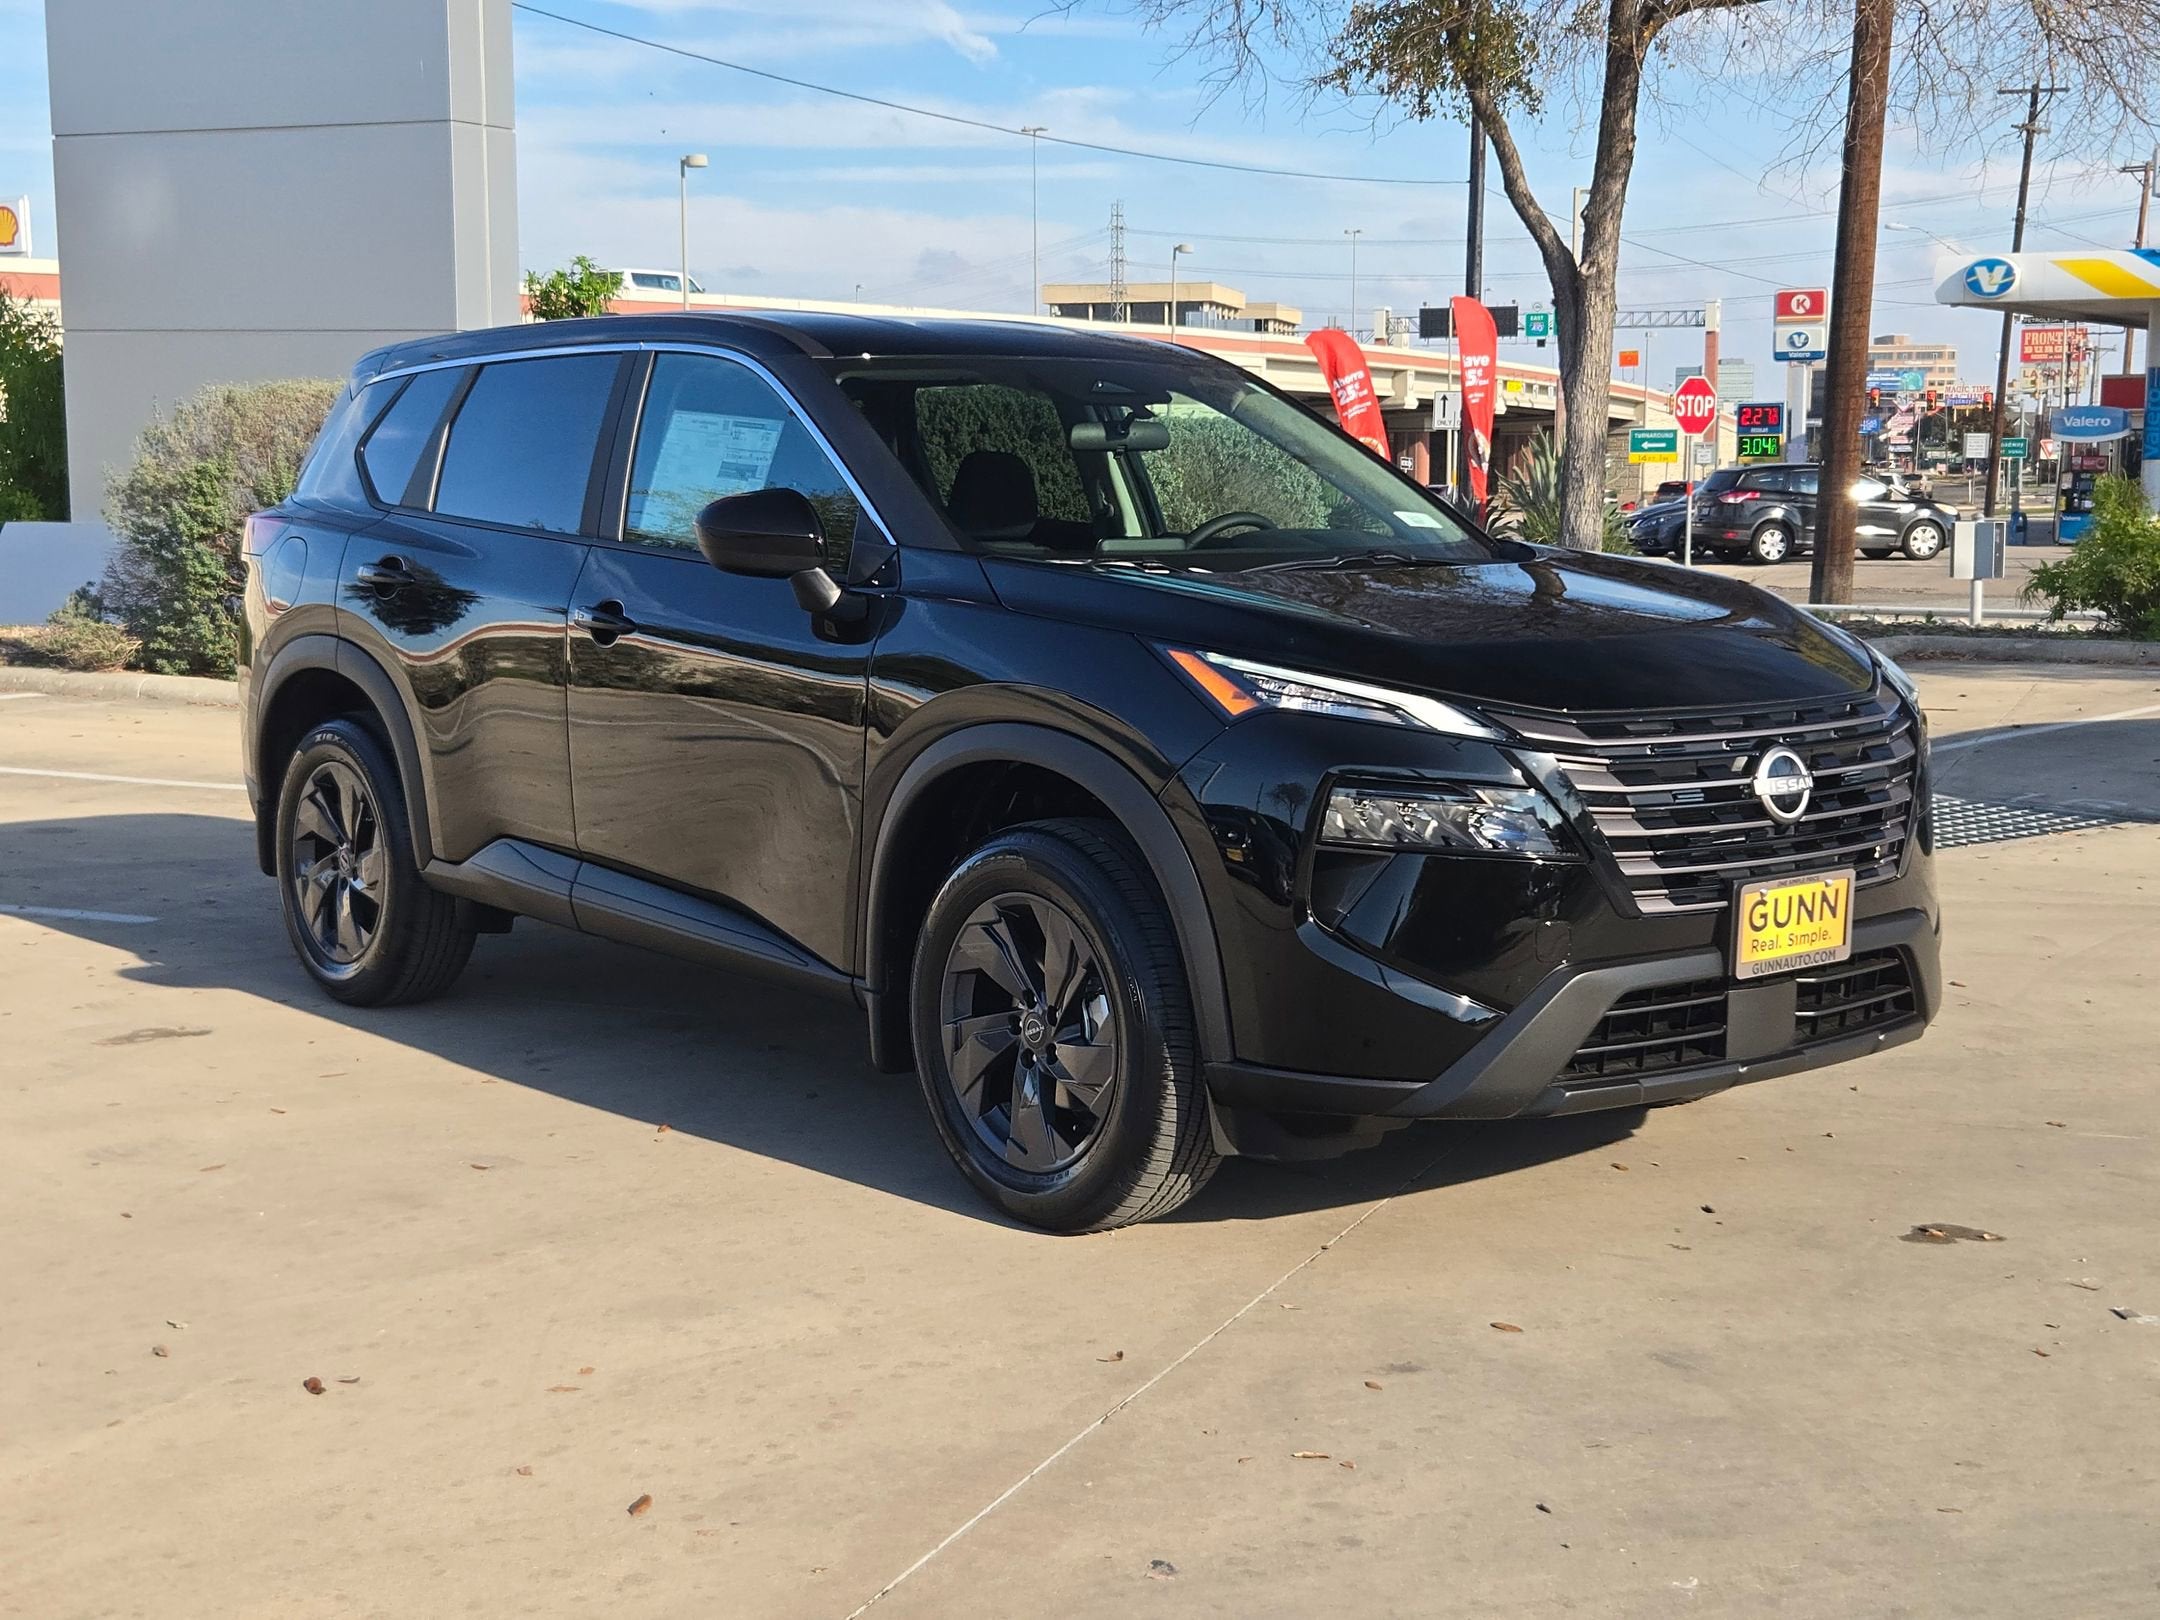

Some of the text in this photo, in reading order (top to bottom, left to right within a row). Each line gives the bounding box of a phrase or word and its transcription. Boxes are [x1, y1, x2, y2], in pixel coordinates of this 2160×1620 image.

[1333, 370, 1365, 390] Ahorra
[2023, 370, 2038, 378] LA
[1946, 385, 1992, 393] MAGIC TIME
[1676, 394, 1714, 418] STOP
[2063, 416, 2111, 427] Valero
[1760, 775, 1814, 794] ISSAN
[1749, 888, 1840, 932] GUNN
[1752, 927, 1832, 953] Real. Simple.
[1752, 949, 1837, 975] GUNNAUTO.COM
